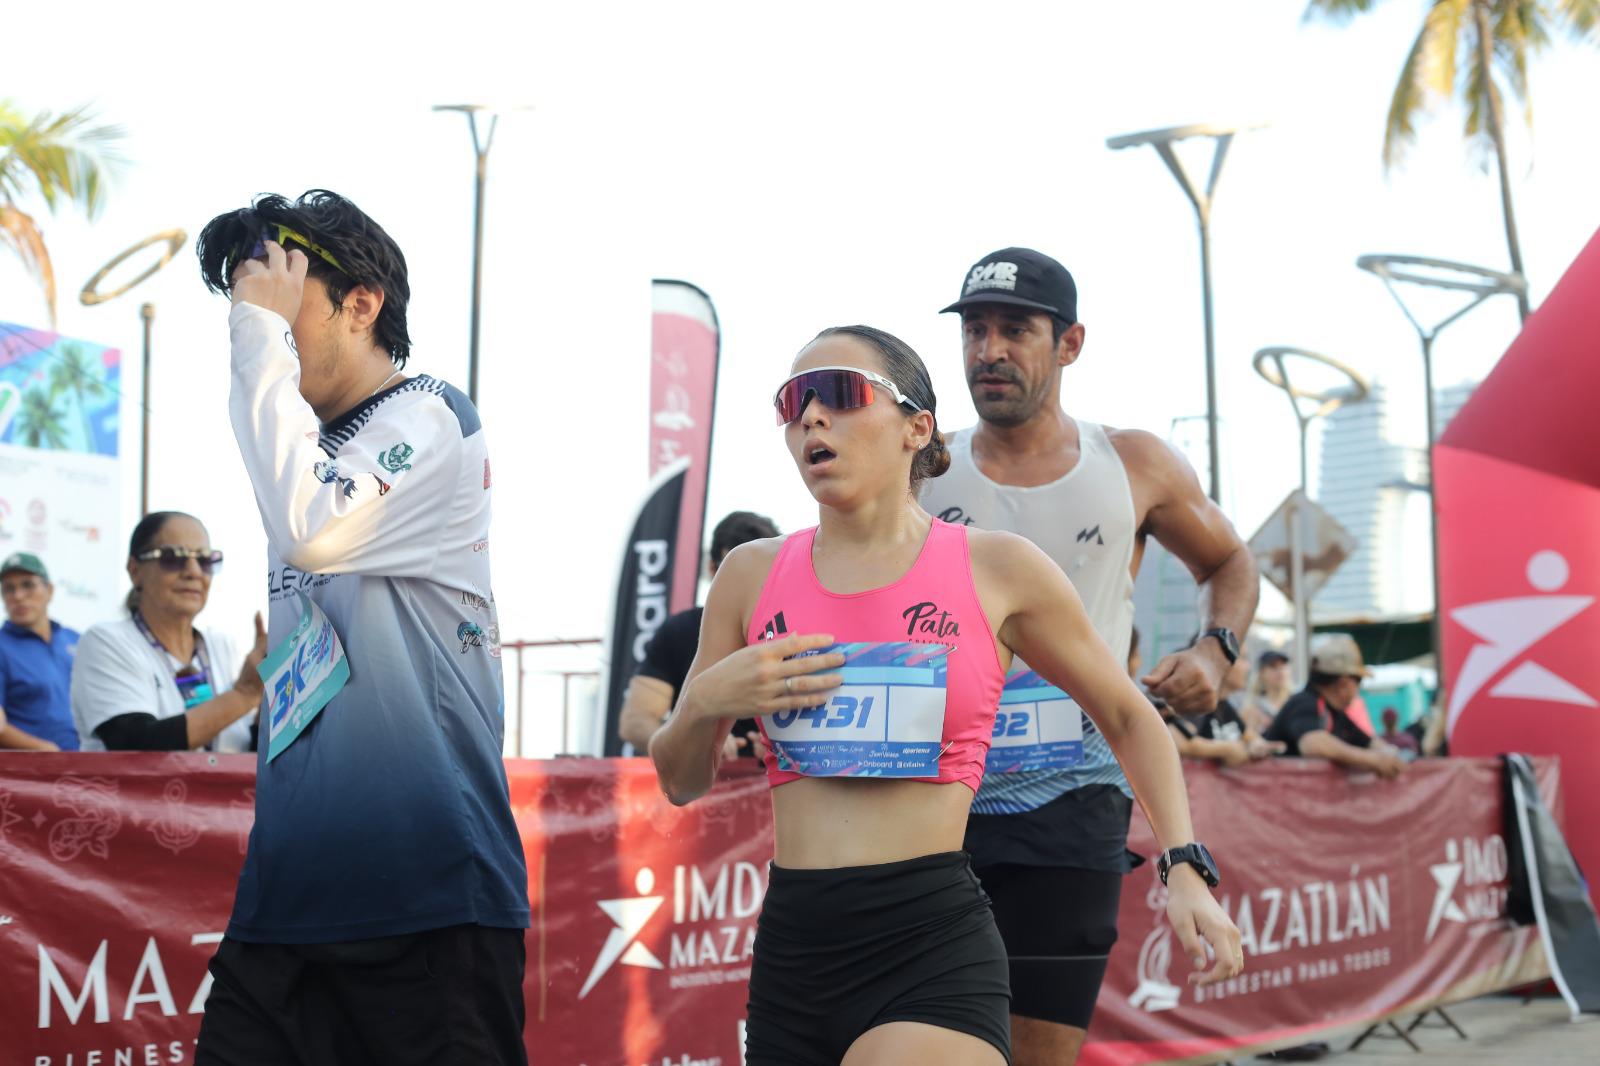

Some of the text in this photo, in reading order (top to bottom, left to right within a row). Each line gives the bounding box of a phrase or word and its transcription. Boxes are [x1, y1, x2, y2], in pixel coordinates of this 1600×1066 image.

[967, 261, 1018, 285] SMR
[902, 601, 961, 638] Pata
[771, 696, 875, 729] 0431
